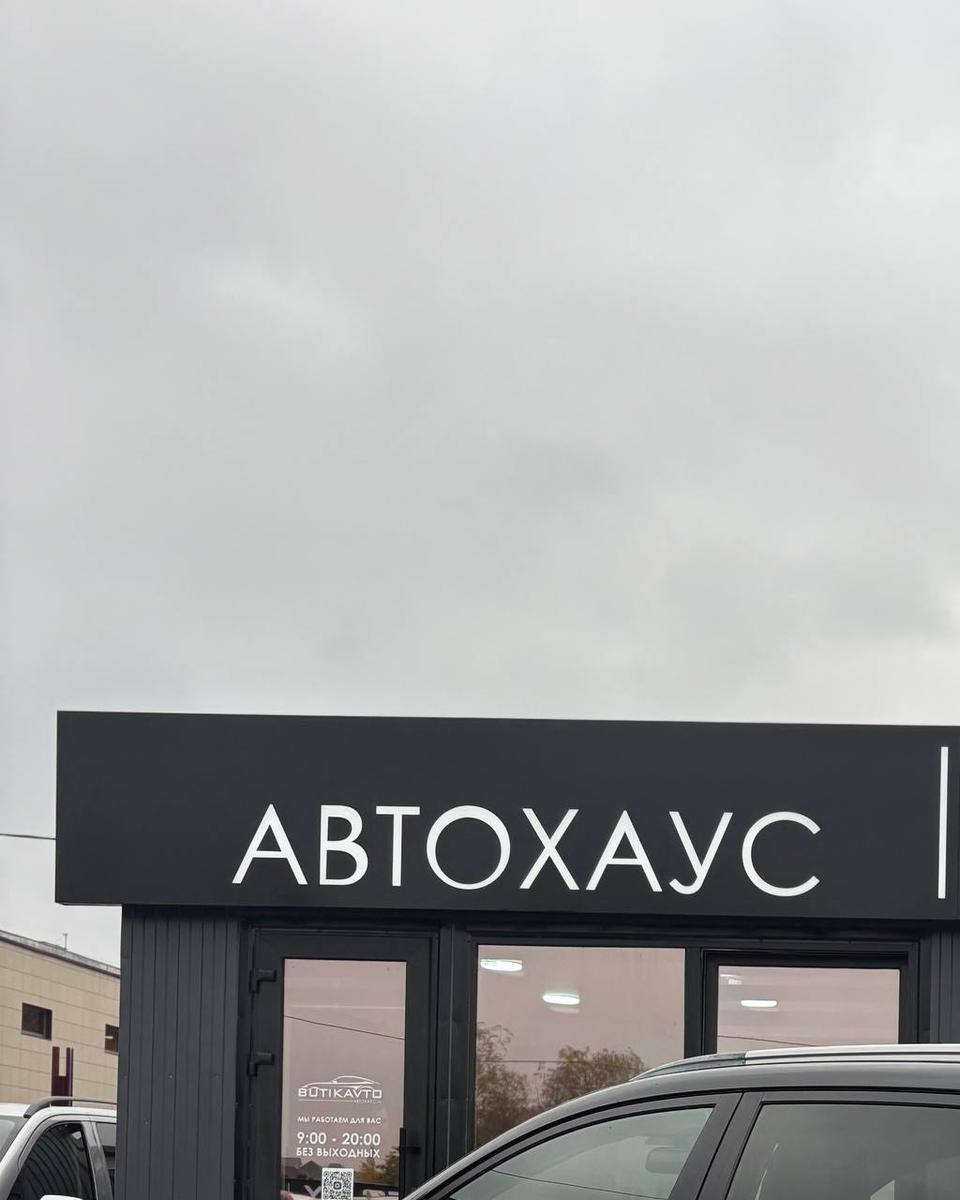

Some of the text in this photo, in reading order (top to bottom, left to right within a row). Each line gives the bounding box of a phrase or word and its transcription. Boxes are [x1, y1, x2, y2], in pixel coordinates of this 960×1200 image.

[230, 803, 821, 898] АВТОХАУС
[298, 1087, 382, 1098] BUTIKAVTO
[297, 1131, 327, 1145] 9:00
[342, 1132, 381, 1146] 20:00
[296, 1147, 380, 1158] БЕЗ ВЫХОДНЫХ
